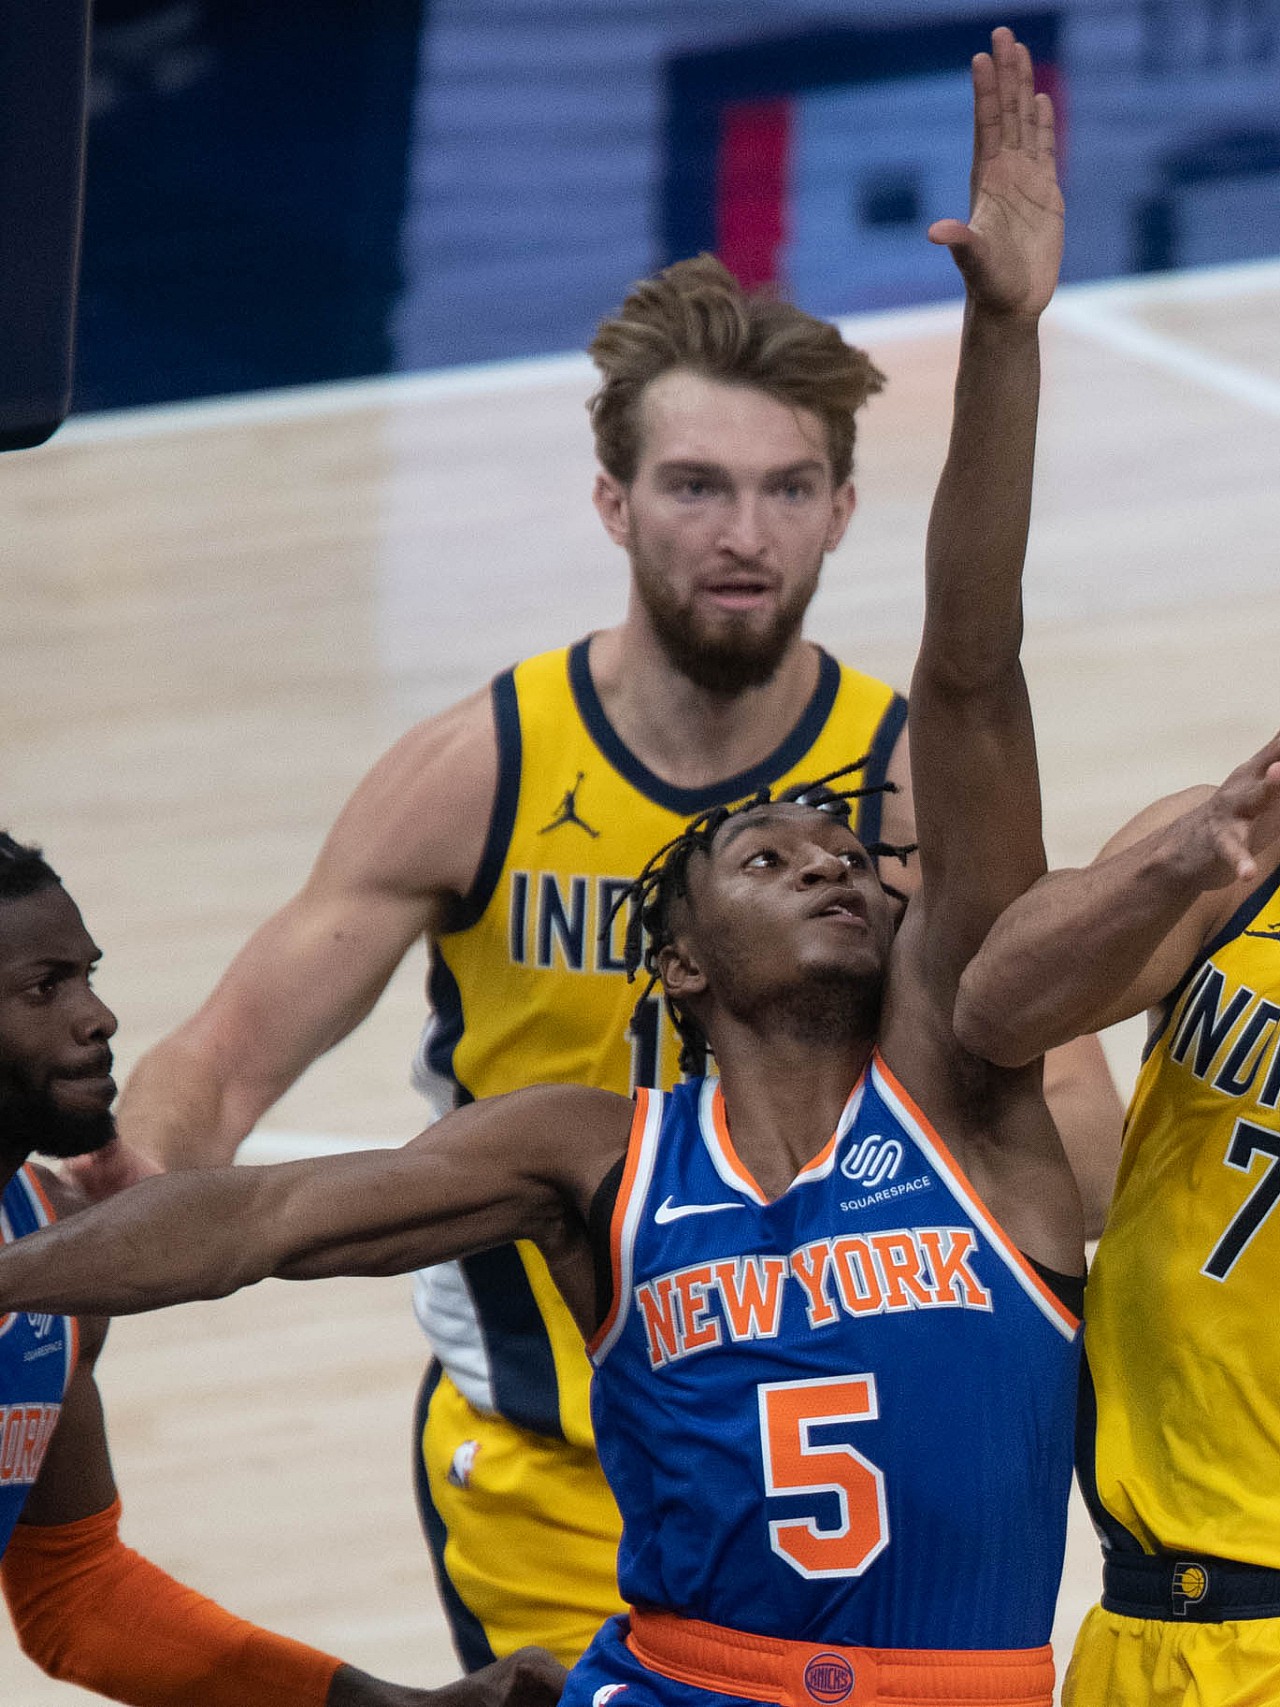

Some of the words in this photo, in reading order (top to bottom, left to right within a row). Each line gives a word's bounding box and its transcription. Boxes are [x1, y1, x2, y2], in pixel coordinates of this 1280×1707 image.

[508, 870, 646, 975] IND
[839, 1175, 932, 1212] SQUARESPACE
[634, 1254, 790, 1371] NEW
[788, 1226, 995, 1330] YORK
[757, 1372, 891, 1580] 5
